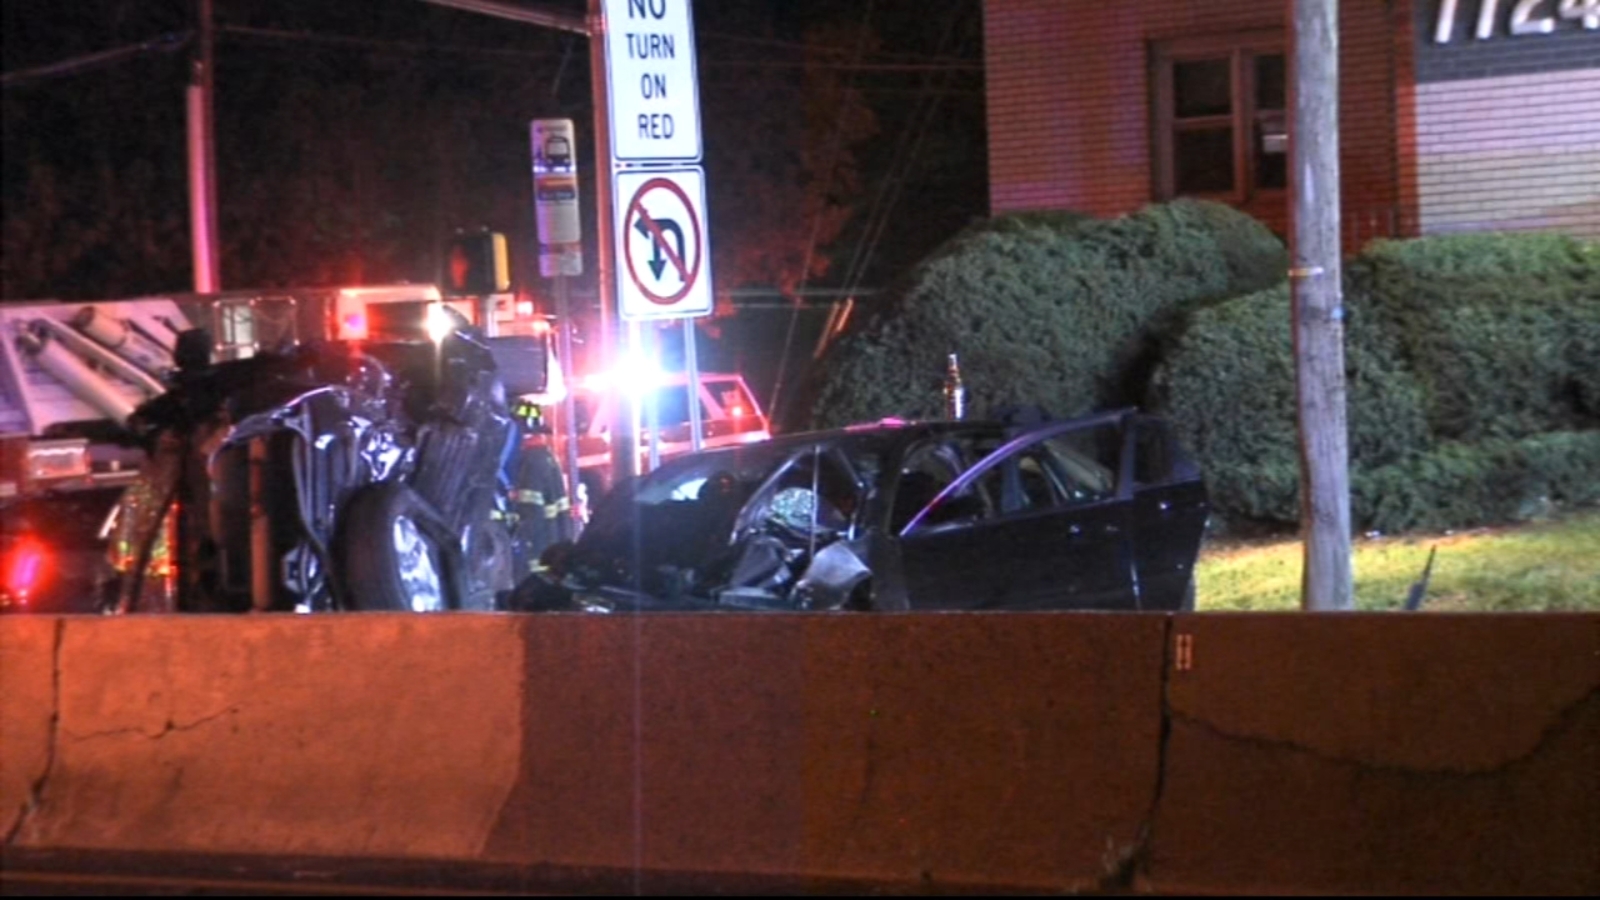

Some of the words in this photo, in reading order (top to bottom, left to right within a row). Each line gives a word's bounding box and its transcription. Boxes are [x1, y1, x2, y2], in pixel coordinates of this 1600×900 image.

[627, 0, 667, 19] NO
[625, 33, 675, 59] TURN
[640, 73, 666, 99] ON
[638, 113, 674, 139] RED
